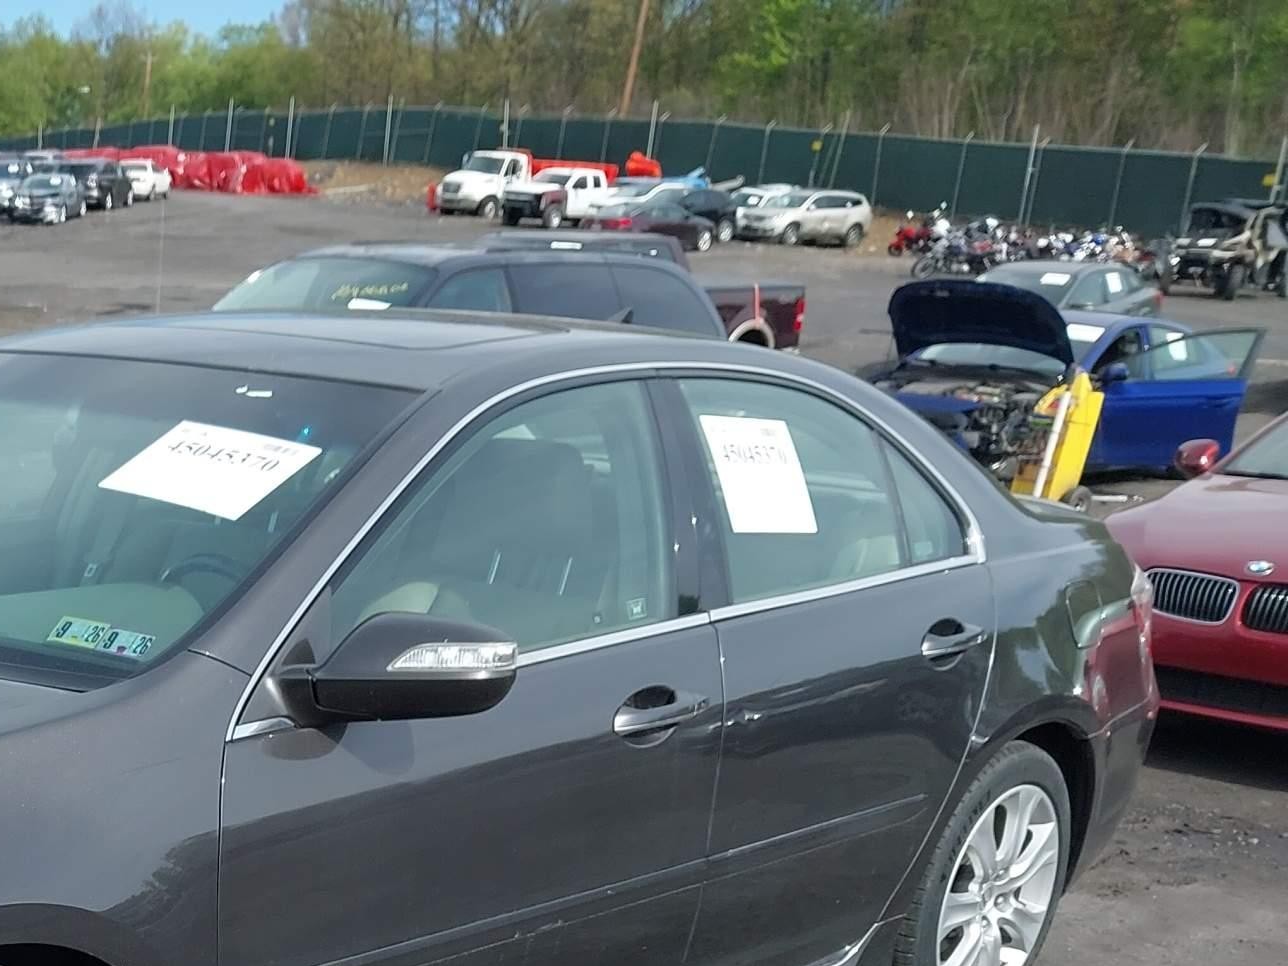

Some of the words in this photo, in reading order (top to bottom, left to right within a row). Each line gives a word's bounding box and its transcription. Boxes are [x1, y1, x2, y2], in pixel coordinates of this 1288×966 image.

[56, 621, 73, 638] 9
[85, 625, 105, 643] 26
[103, 631, 119, 649] 9
[133, 637, 153, 655] 26
